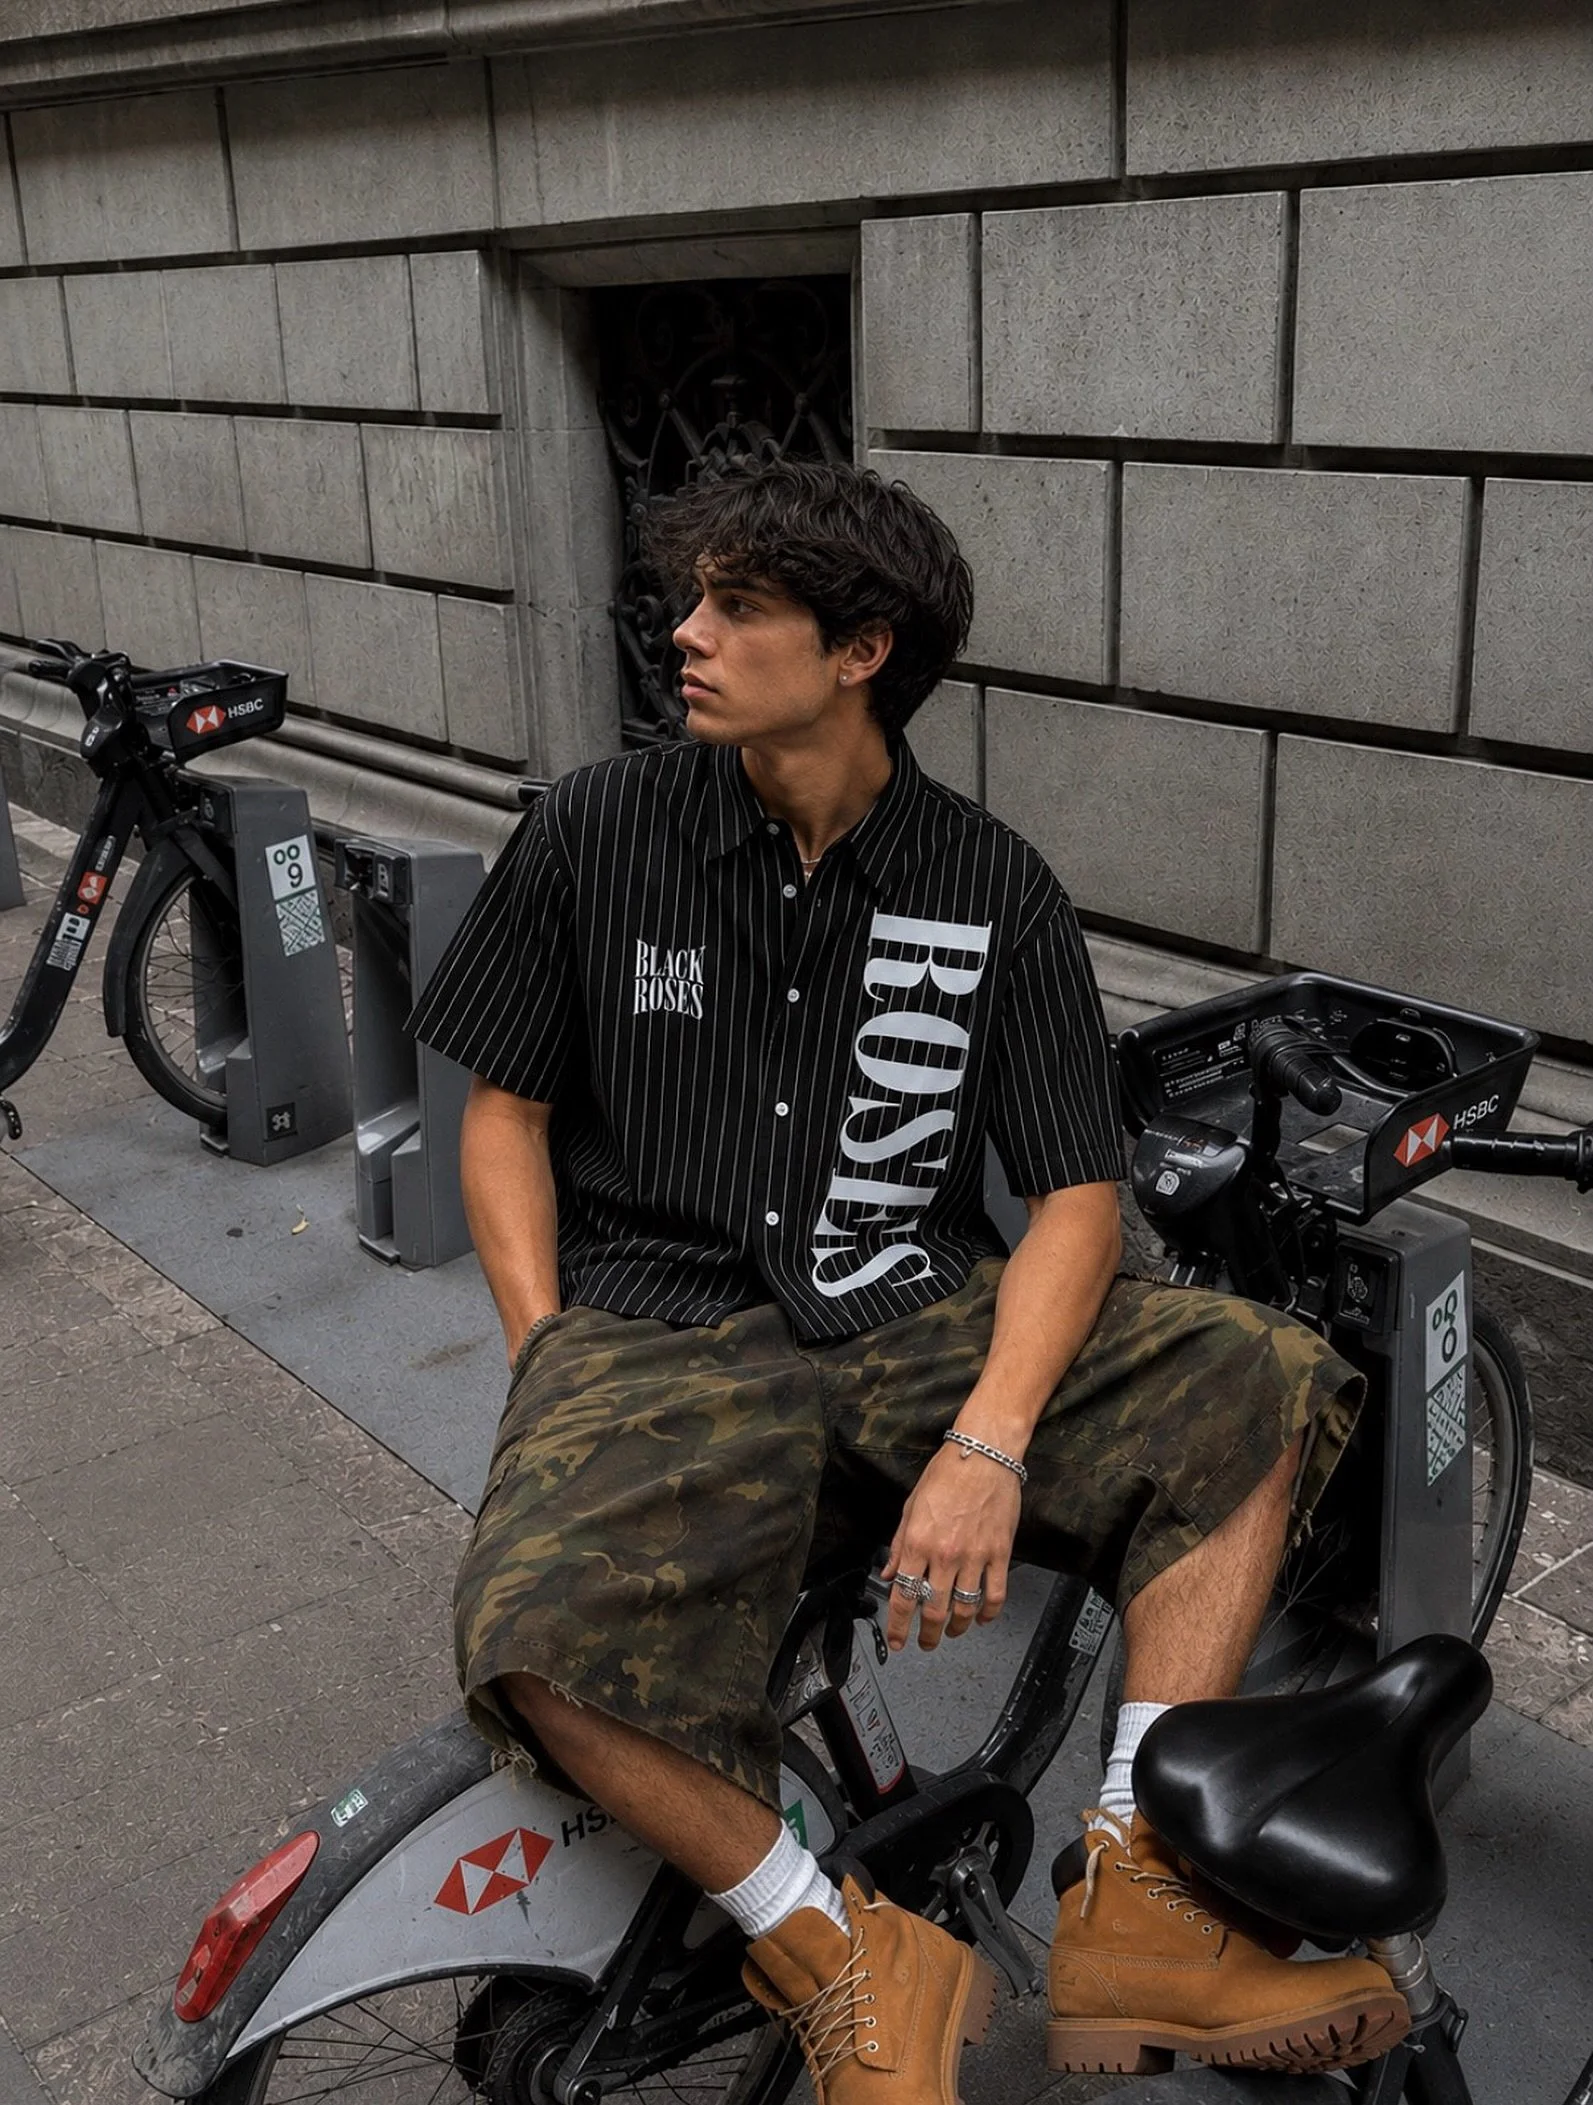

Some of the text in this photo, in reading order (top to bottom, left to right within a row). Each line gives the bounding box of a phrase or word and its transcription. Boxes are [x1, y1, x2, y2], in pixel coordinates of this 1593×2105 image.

[227, 698, 264, 719] HSBC
[634, 938, 706, 985] BLACK
[633, 977, 704, 1020] ROSES
[811, 907, 993, 1298] ROSES
[1453, 1094, 1499, 1130] HSBC
[561, 1804, 616, 1848] HS
